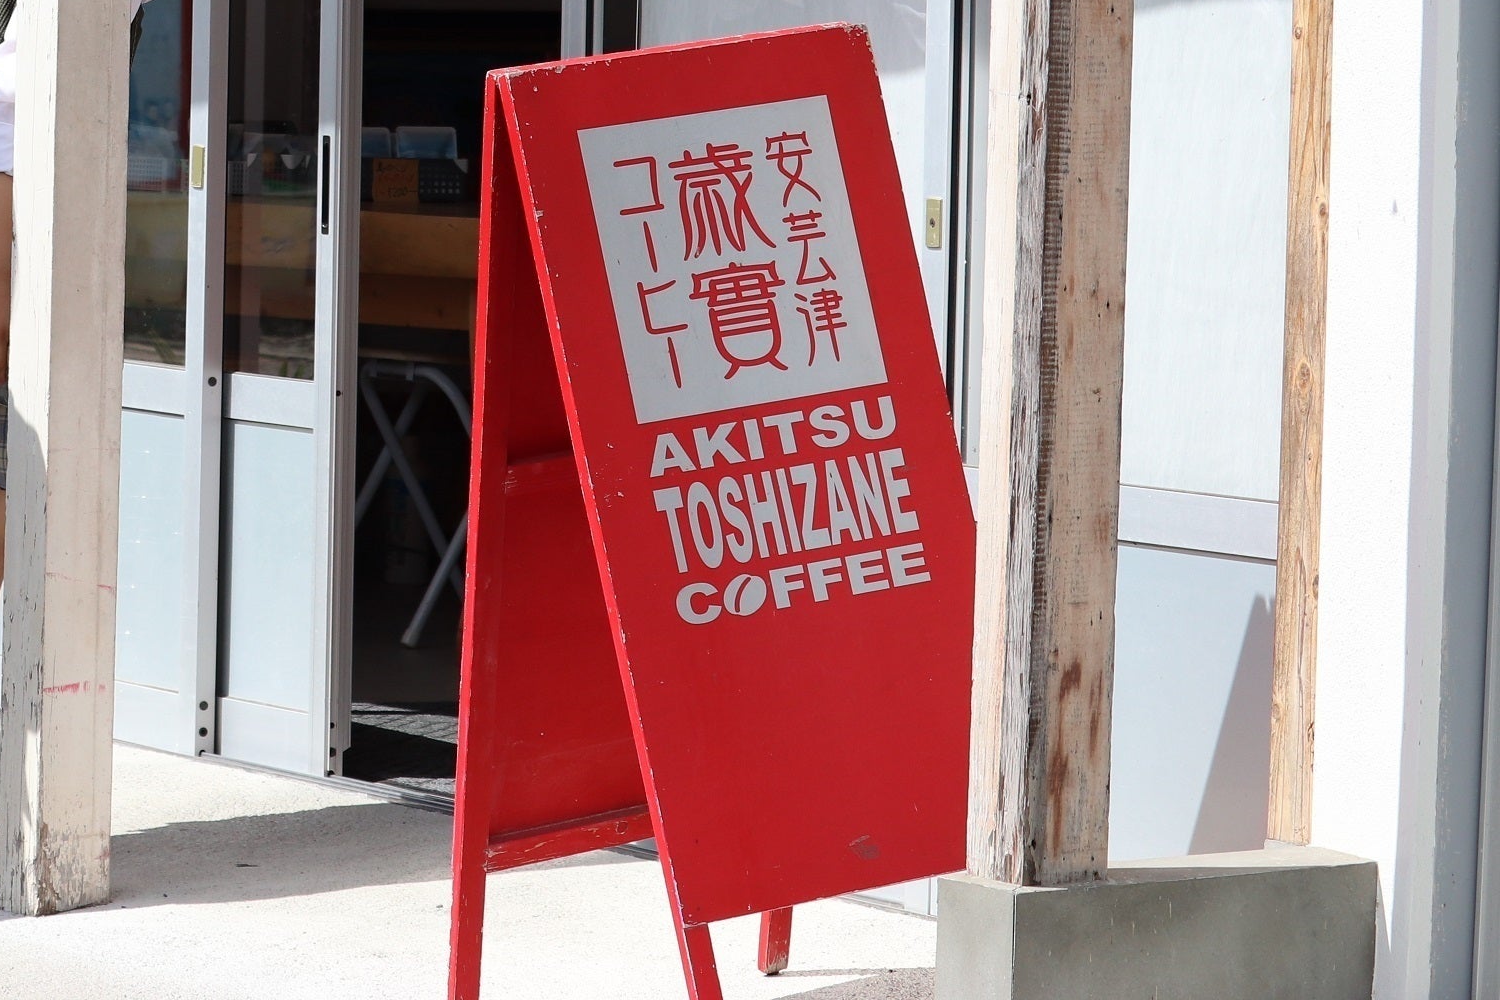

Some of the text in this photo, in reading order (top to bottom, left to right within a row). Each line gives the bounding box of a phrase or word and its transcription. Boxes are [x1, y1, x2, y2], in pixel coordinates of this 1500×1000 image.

[613, 156, 688, 388] コーヒー
[765, 130, 848, 366] 安芸津
[650, 396, 898, 477] AKITSU
[654, 448, 920, 573] TOSHIZANE
[676, 543, 931, 624] COFFEE
